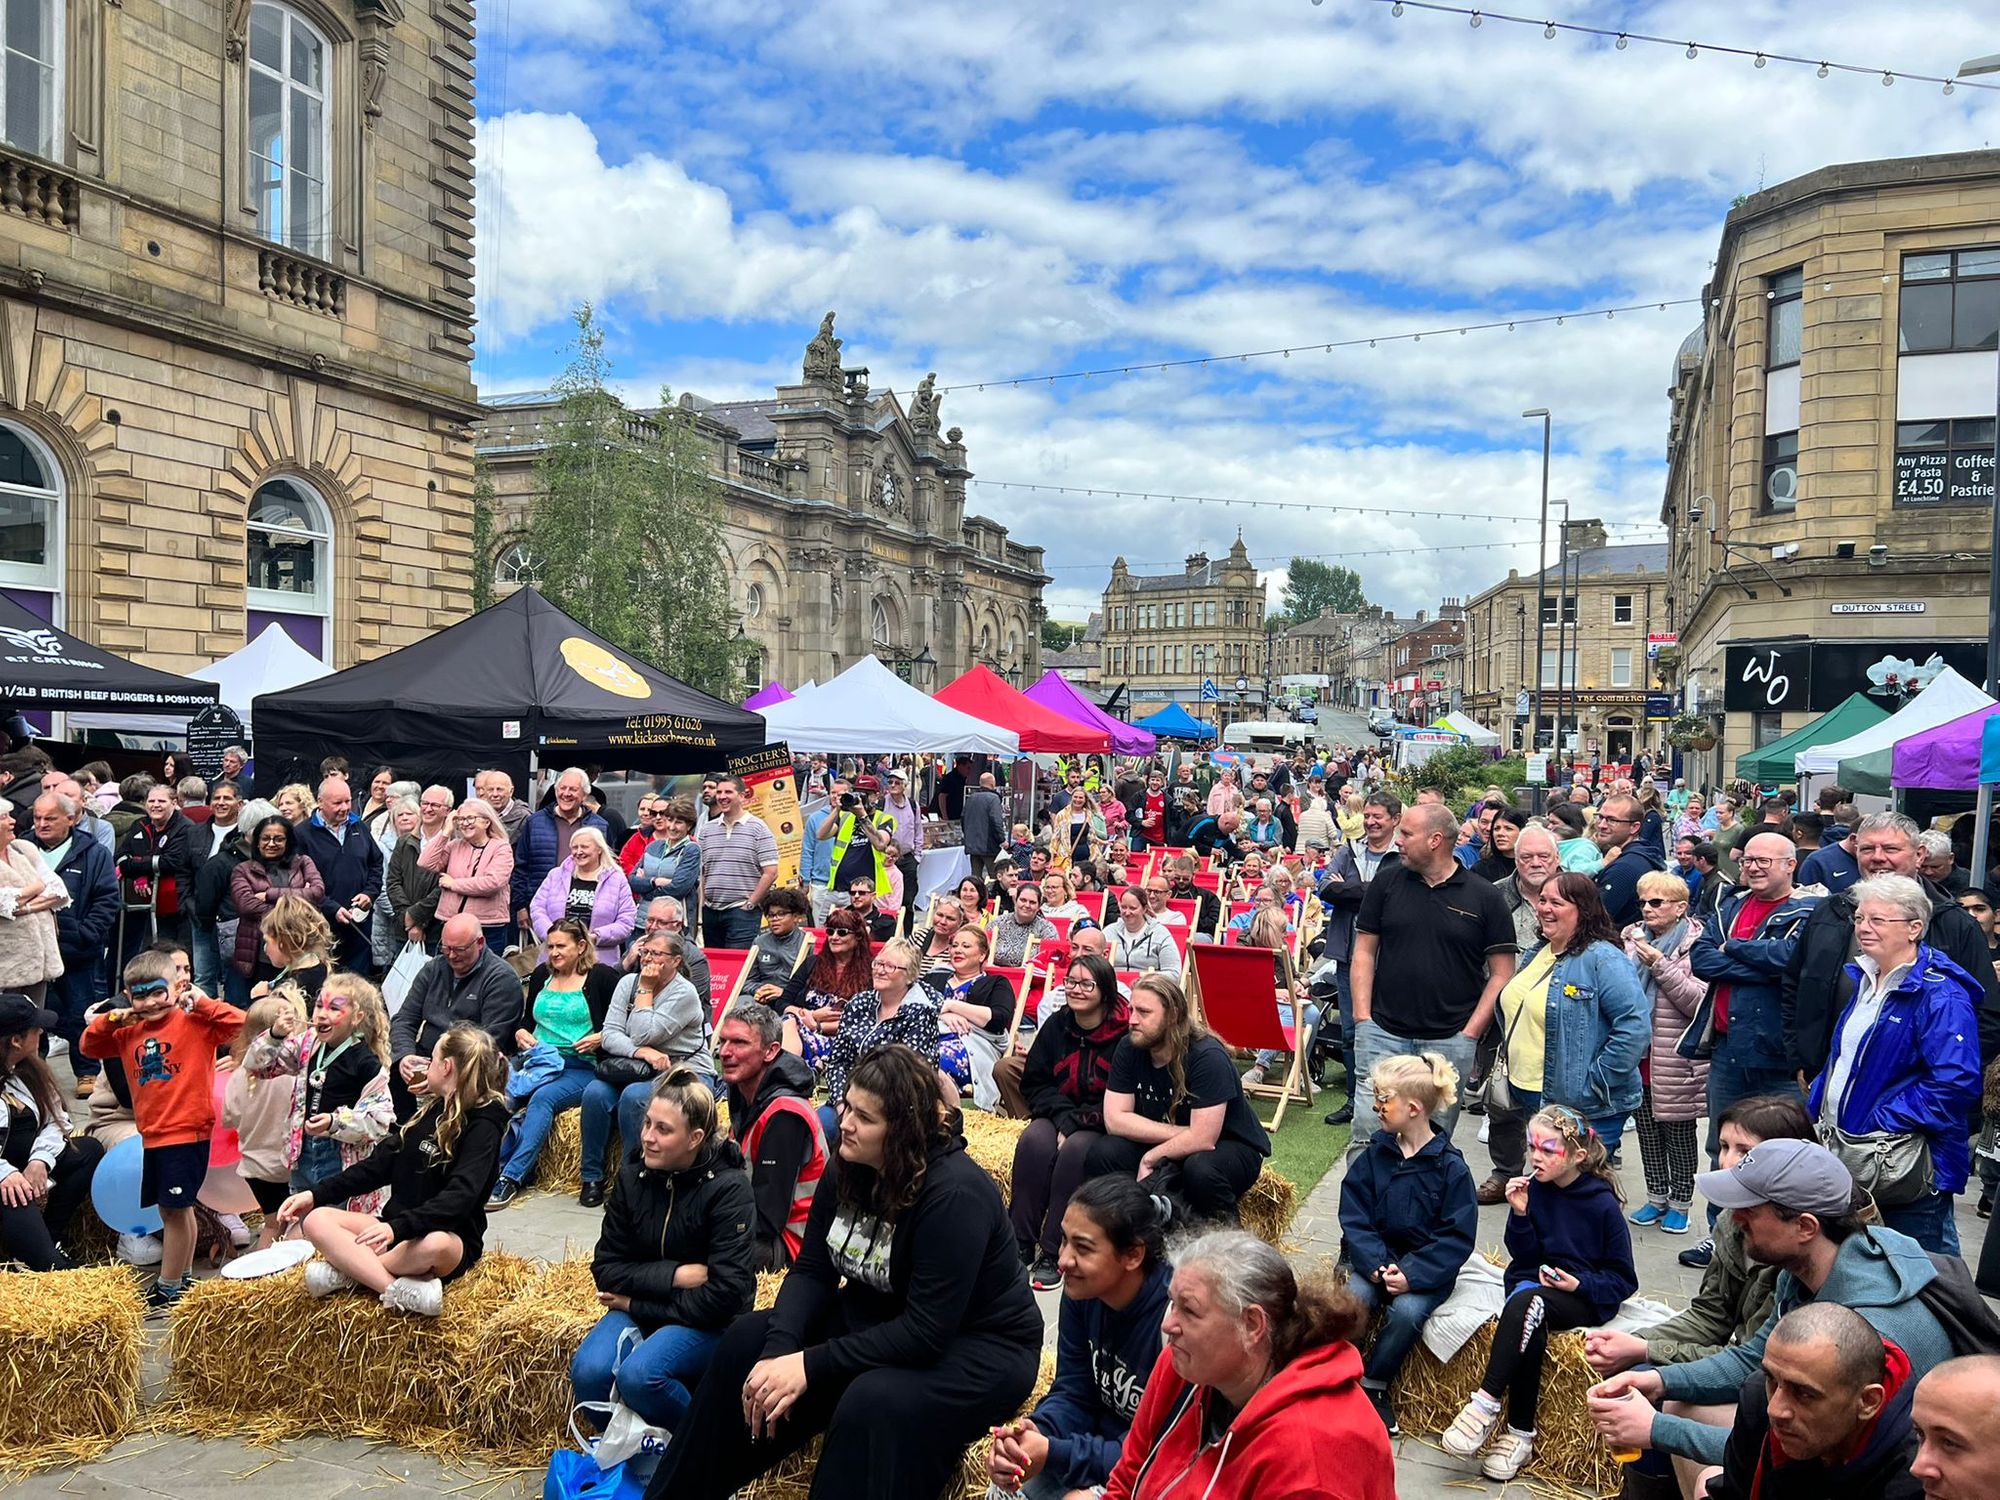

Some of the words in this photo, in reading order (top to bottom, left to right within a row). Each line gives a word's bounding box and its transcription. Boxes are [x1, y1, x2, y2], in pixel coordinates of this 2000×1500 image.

[1897, 456, 1917, 468] Any
[1920, 455, 1947, 465] Pizza
[1955, 454, 1996, 469] Coffee
[1900, 470, 1911, 478] or
[1914, 468, 1942, 478] Pasta
[1971, 470, 1981, 482] &
[1898, 479, 1944, 496] £4.50
[1842, 604, 1881, 612] DUTTON
[4, 685, 37, 698] 1/2LB
[41, 688, 82, 699] BRITISH
[84, 691, 109, 700] BEEF
[110, 692, 155, 702] BURGERS
[156, 695, 163, 703] &
[164, 695, 189, 704] POSH
[191, 696, 215, 704] DOGS
[625, 716, 641, 729] Tel:
[643, 715, 672, 729] 01995
[674, 716, 702, 731] 61626
[608, 730, 717, 747] www.kickasscheese.co.uk
[728, 747, 788, 769] PROCTER'S
[729, 764, 759, 776] CHEESES
[760, 757, 789, 770] LIMITED
